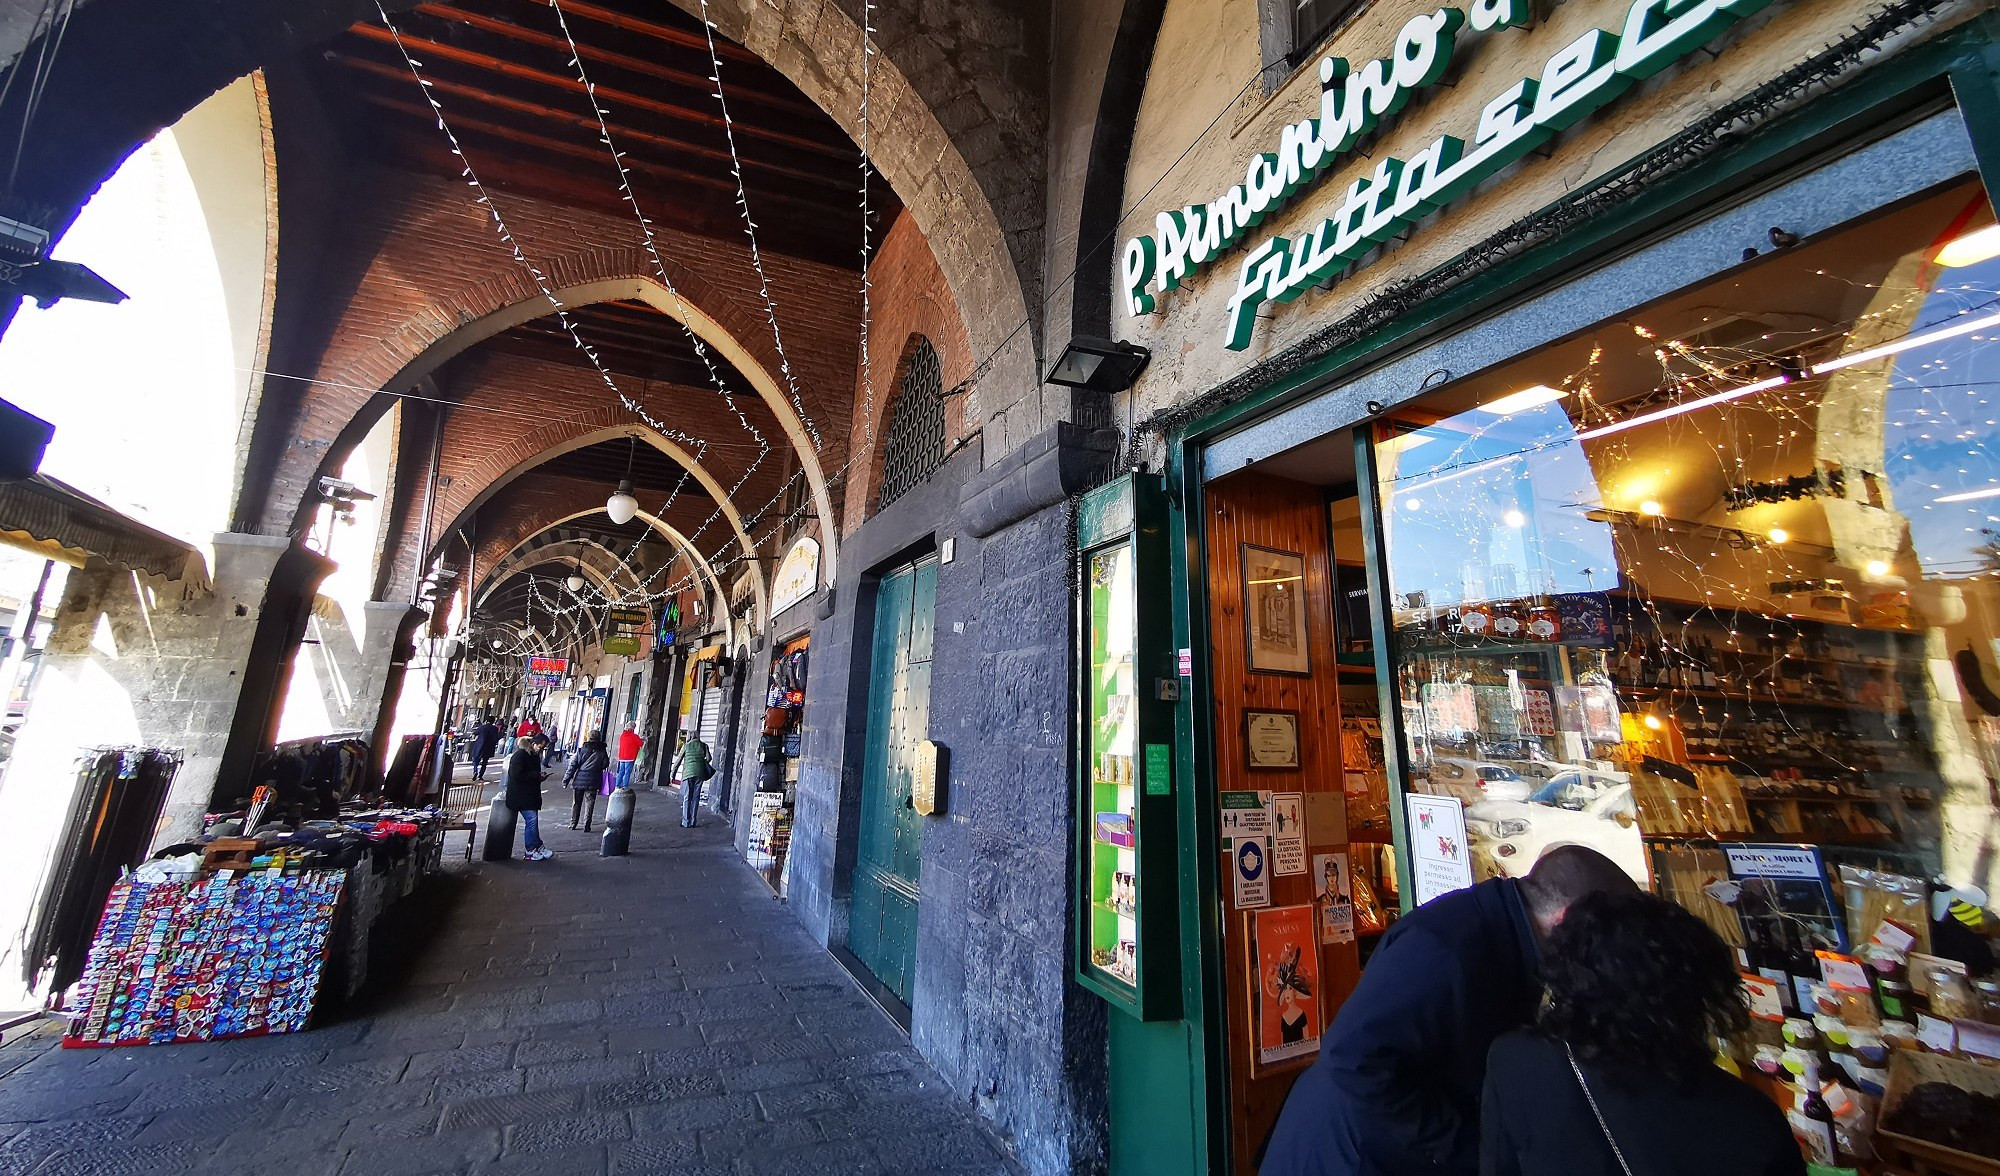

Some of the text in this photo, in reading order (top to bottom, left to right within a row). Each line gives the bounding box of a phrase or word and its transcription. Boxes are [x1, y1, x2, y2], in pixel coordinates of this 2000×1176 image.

[1121, 7, 1452, 318] P. Armanino
[1224, 134, 1463, 350] Frutta
[1561, 594, 1581, 602] TOY
[1582, 596, 1603, 609] SHOP
[1731, 854, 1765, 862] PESTO
[1429, 863, 1454, 872] Ingresso
[1424, 870, 1452, 881] permesso
